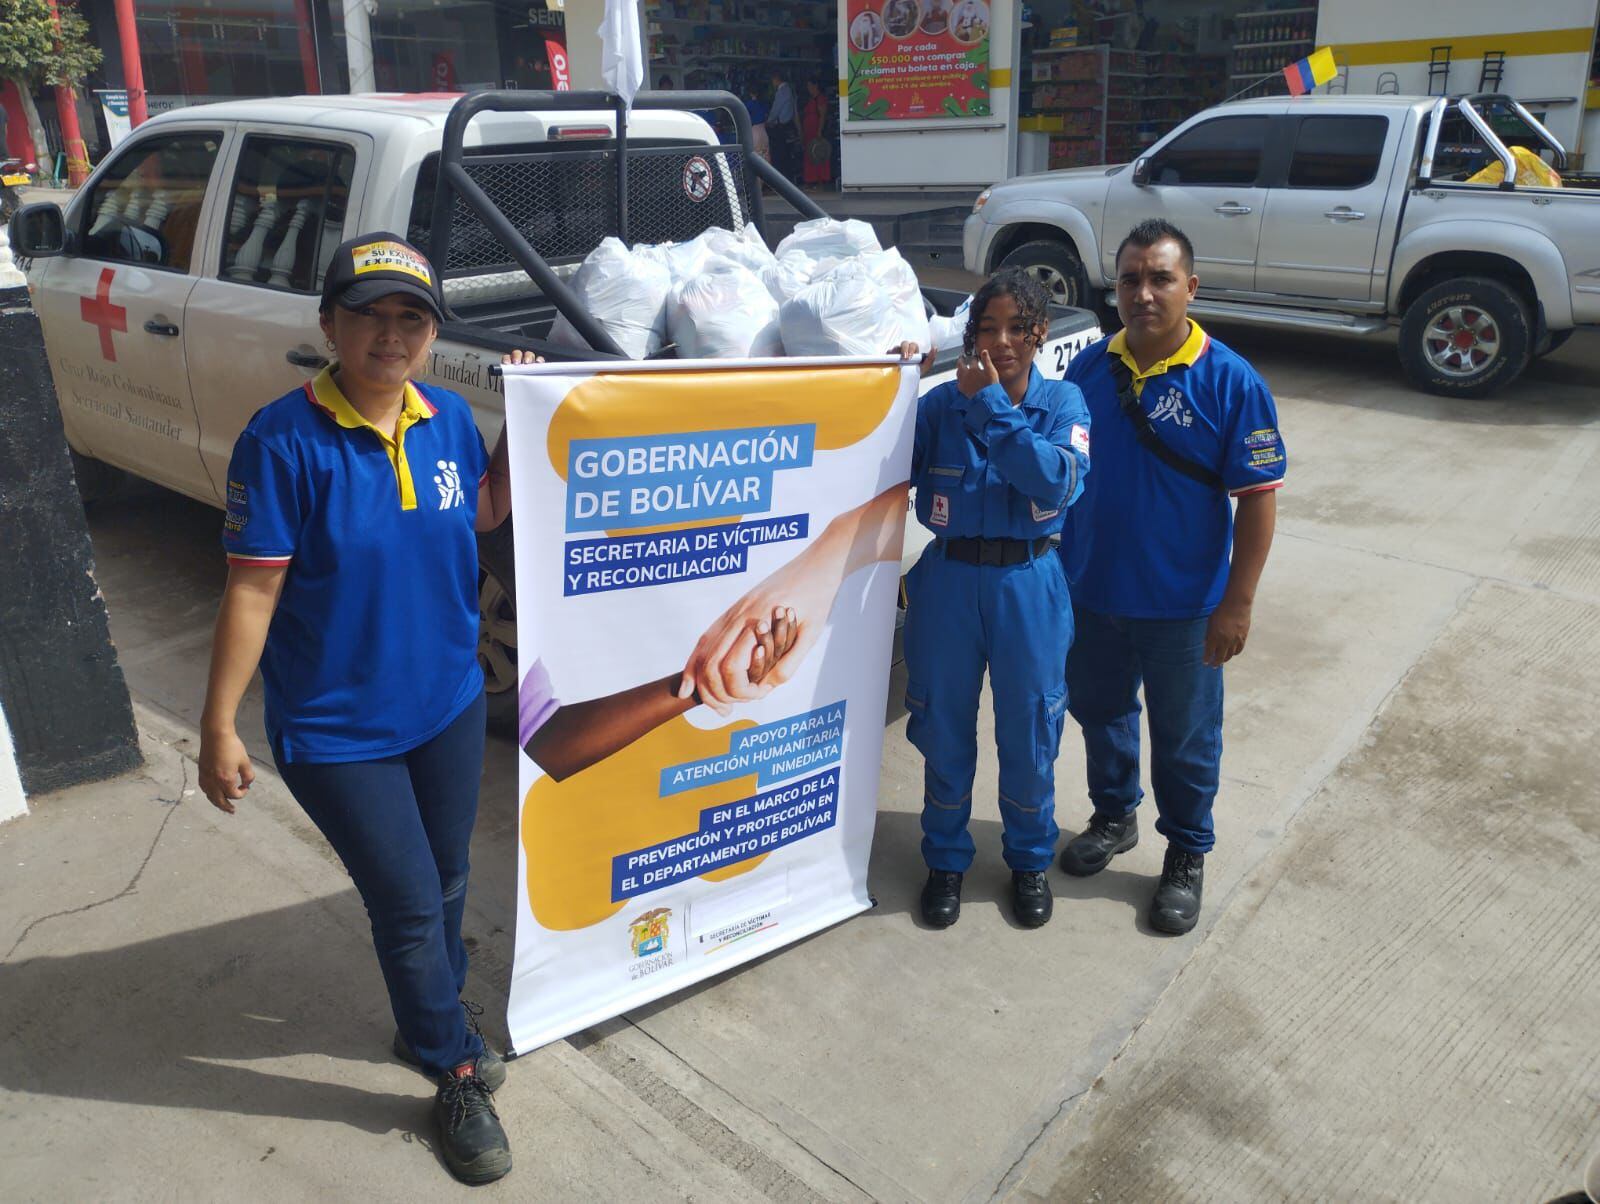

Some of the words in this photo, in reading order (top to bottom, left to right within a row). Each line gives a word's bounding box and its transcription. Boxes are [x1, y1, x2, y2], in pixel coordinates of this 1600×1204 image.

[897, 45, 912, 53] Por
[915, 43, 937, 51] cada
[927, 52, 966, 63] compras
[861, 66, 896, 76] reclama
[897, 65, 907, 74] tu
[908, 64, 938, 74] boleta
[940, 63, 953, 71] en
[371, 249, 385, 257] SU
[433, 353, 481, 388] Unidad
[125, 406, 182, 441] Santander
[575, 430, 799, 478] GOBERNACIÓN
[574, 490, 621, 519] DE
[630, 475, 761, 515] BOLÍVAR
[569, 536, 688, 565] SECRETARIA
[694, 532, 719, 551] DE
[722, 521, 799, 547] VÍCTIMAS
[568, 573, 583, 591] Y
[586, 551, 742, 589] RECONCILIACIÓN
[739, 727, 787, 750] APOYO
[790, 715, 825, 736] PARA
[827, 709, 843, 723] LA
[673, 754, 750, 784] ATENCIÓN
[752, 727, 841, 764] HUMANITARIA
[771, 744, 839, 776] INMEDIATA
[712, 809, 732, 824] EN
[735, 804, 751, 818] EL
[754, 789, 799, 813] MARCO
[802, 781, 818, 795] DE
[820, 774, 835, 789] LA
[621, 878, 639, 892] EL
[643, 838, 758, 885] DEPARTAMENTO
[761, 831, 778, 847] DE
[781, 810, 832, 839] BOLÍVAR
[628, 831, 721, 870] PREVENCIÓN
[723, 826, 736, 840] Y
[737, 799, 816, 838] PROTECCIÓN
[818, 792, 834, 809] EN
